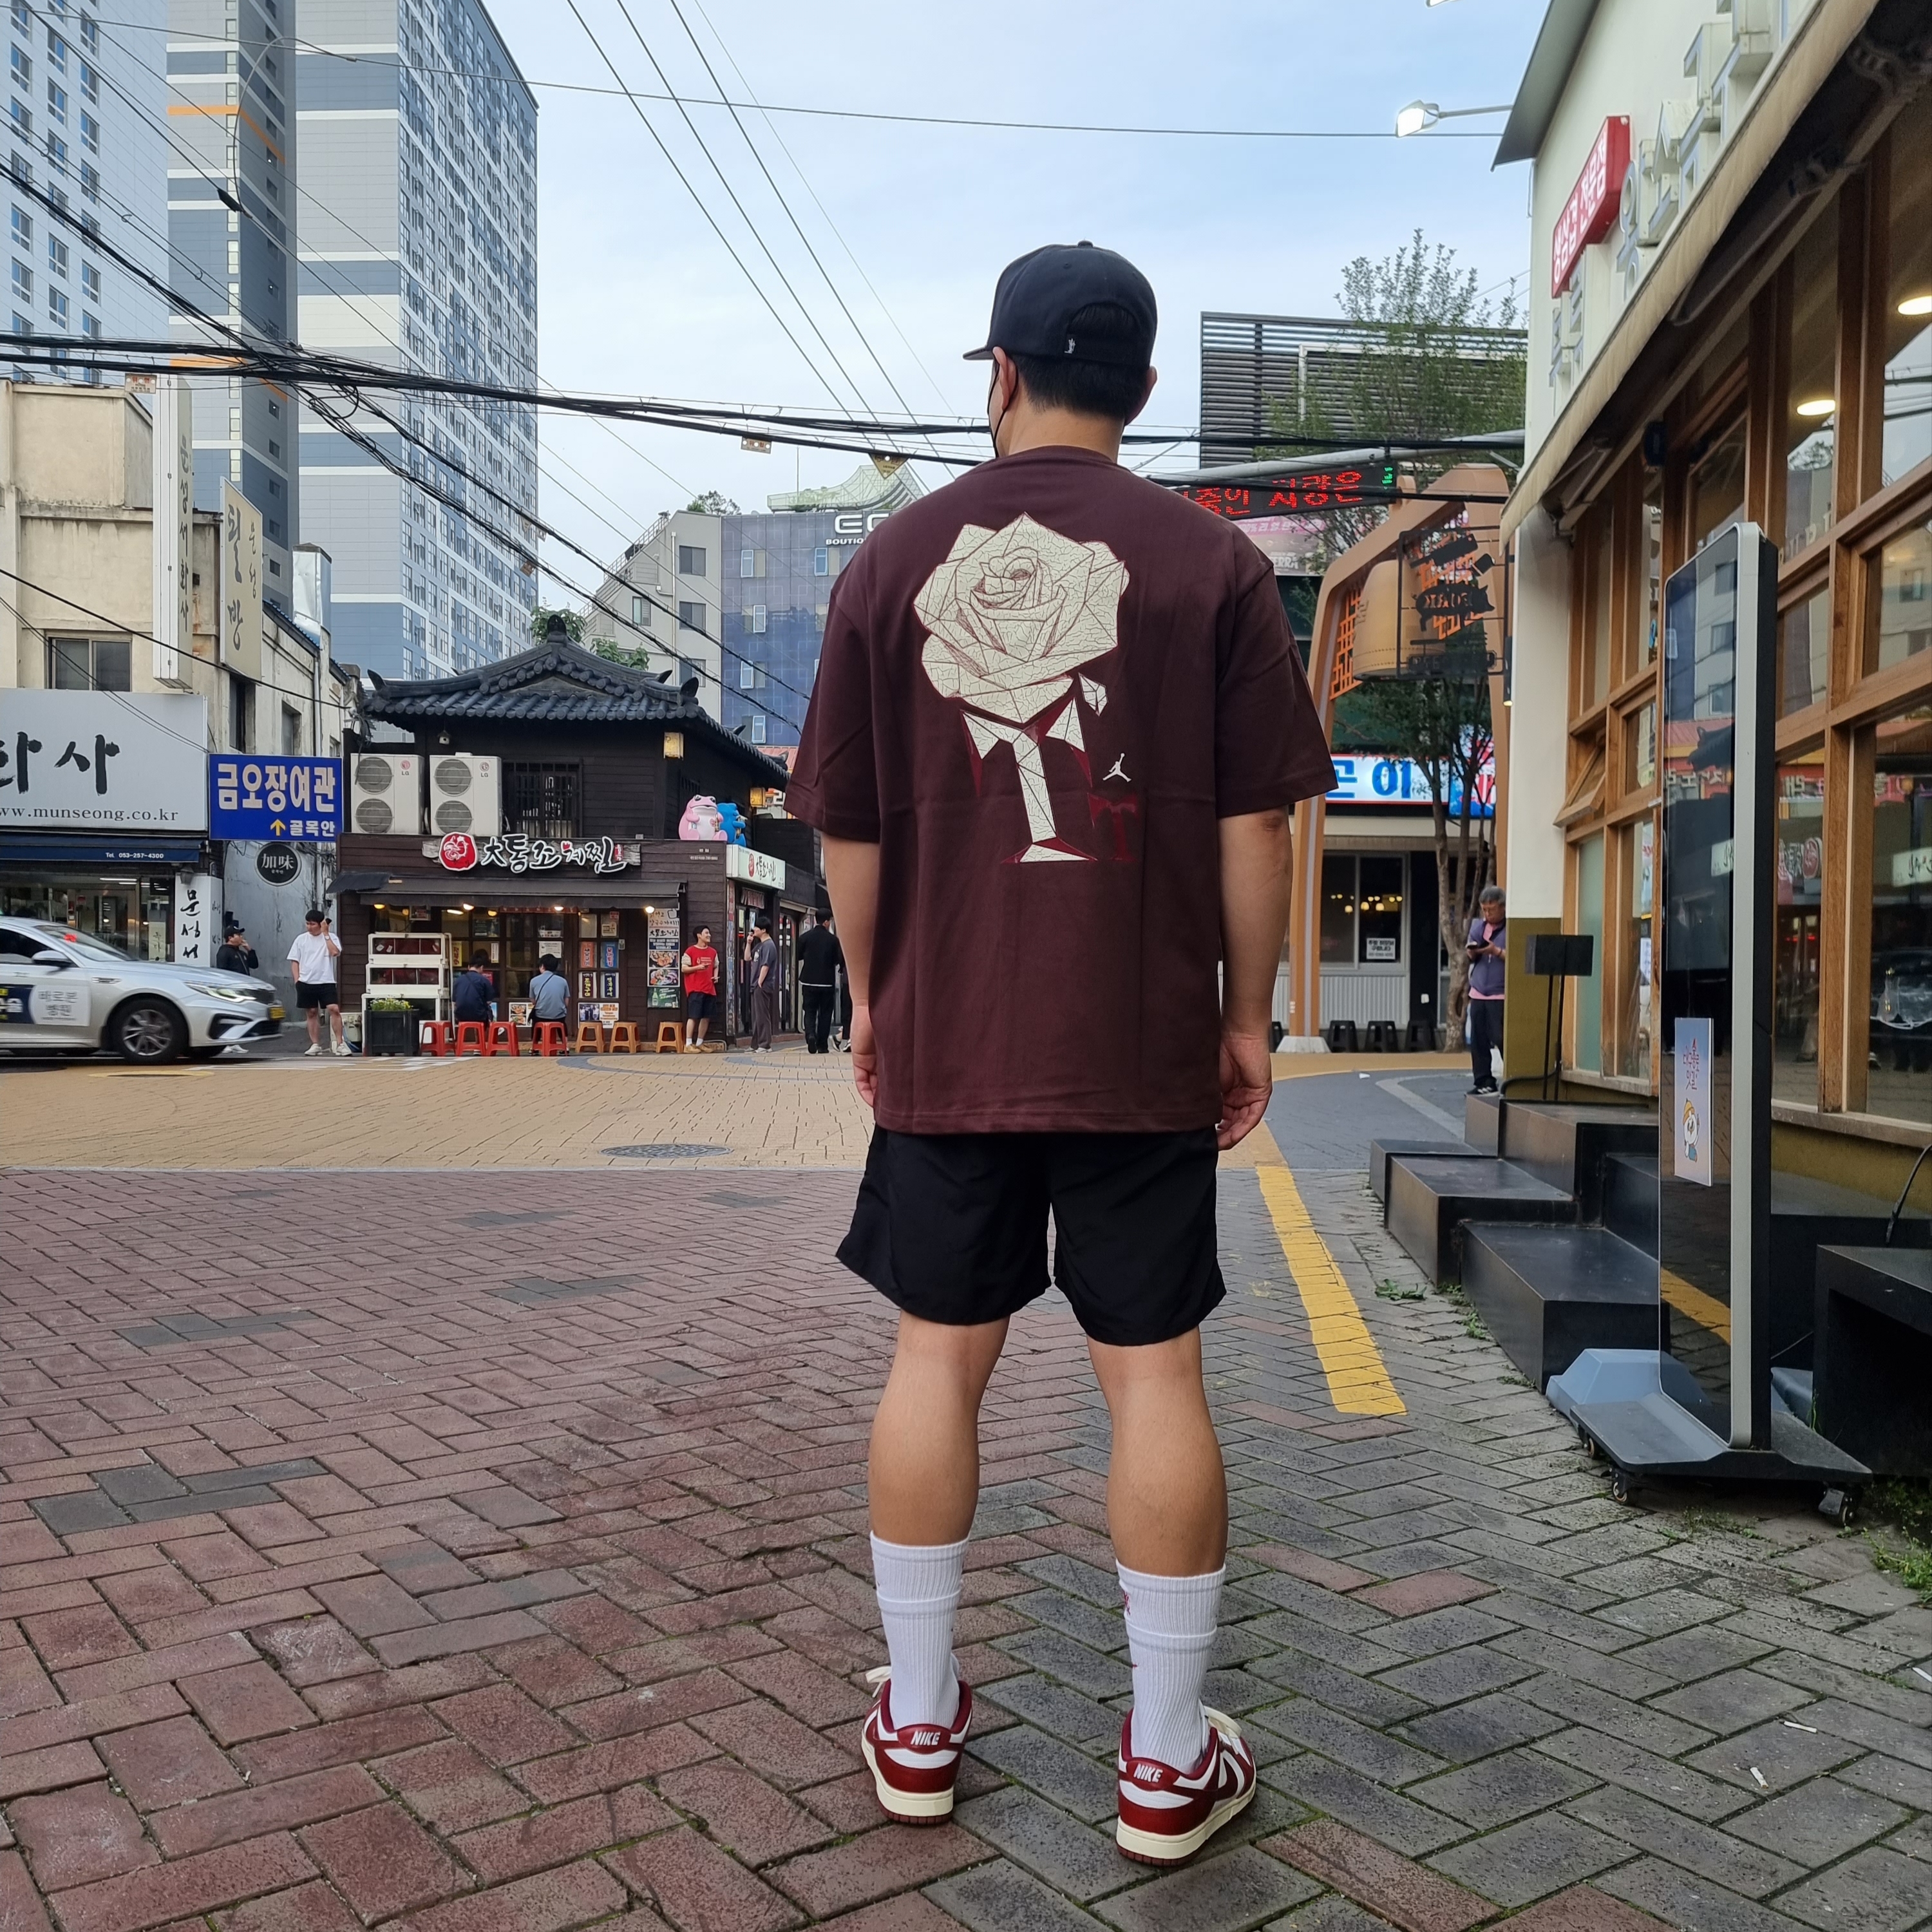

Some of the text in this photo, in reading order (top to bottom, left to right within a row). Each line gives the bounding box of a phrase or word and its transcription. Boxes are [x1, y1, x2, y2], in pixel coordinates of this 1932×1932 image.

[218, 763, 336, 813] 금오장여관
[290, 820, 335, 837] 골목안
[261, 853, 294, 870] 加味
[911, 1731, 941, 1746] NIKE
[1133, 1763, 1162, 1783] NIKE
